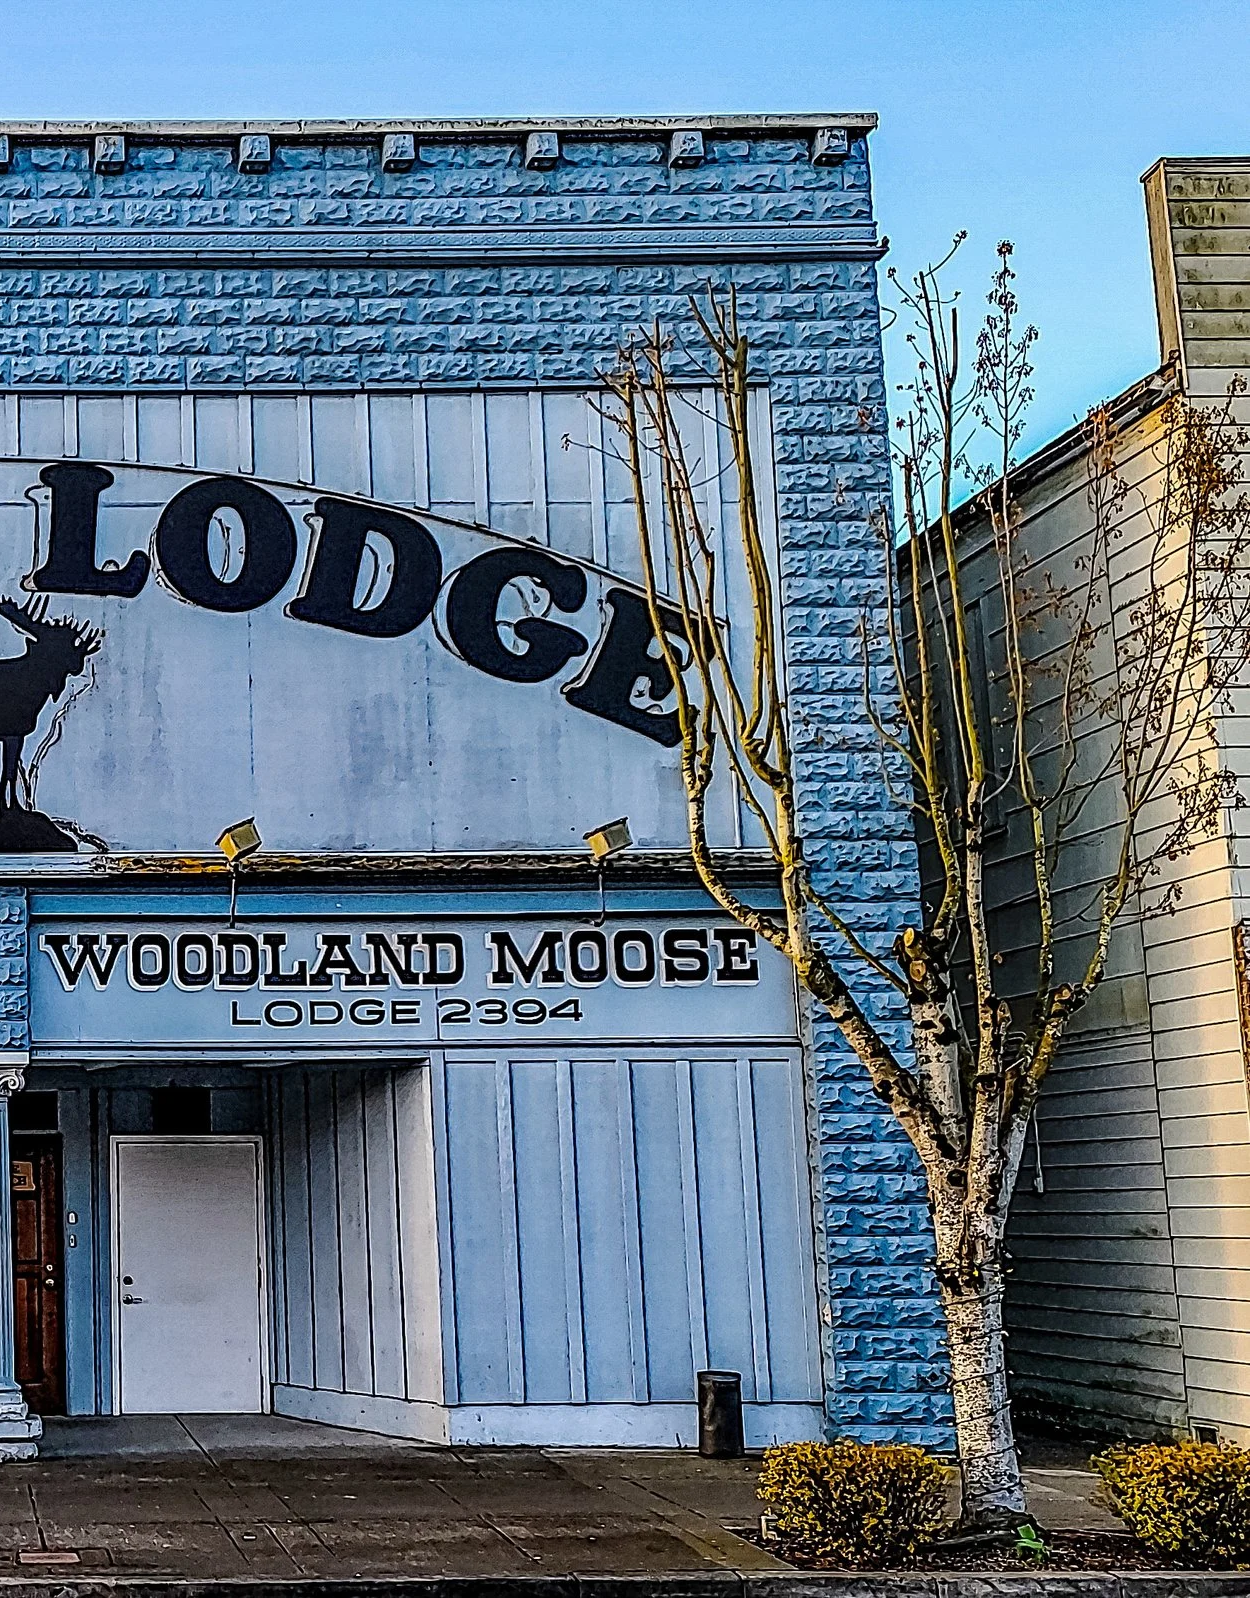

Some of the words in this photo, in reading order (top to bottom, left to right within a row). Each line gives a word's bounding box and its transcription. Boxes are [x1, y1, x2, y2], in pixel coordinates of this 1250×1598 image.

[22, 461, 716, 748] LODGE
[40, 930, 465, 992] WOODLAND
[486, 927, 760, 989] MOOSE
[231, 999, 422, 1027] LODGE
[438, 997, 584, 1025] 2394
